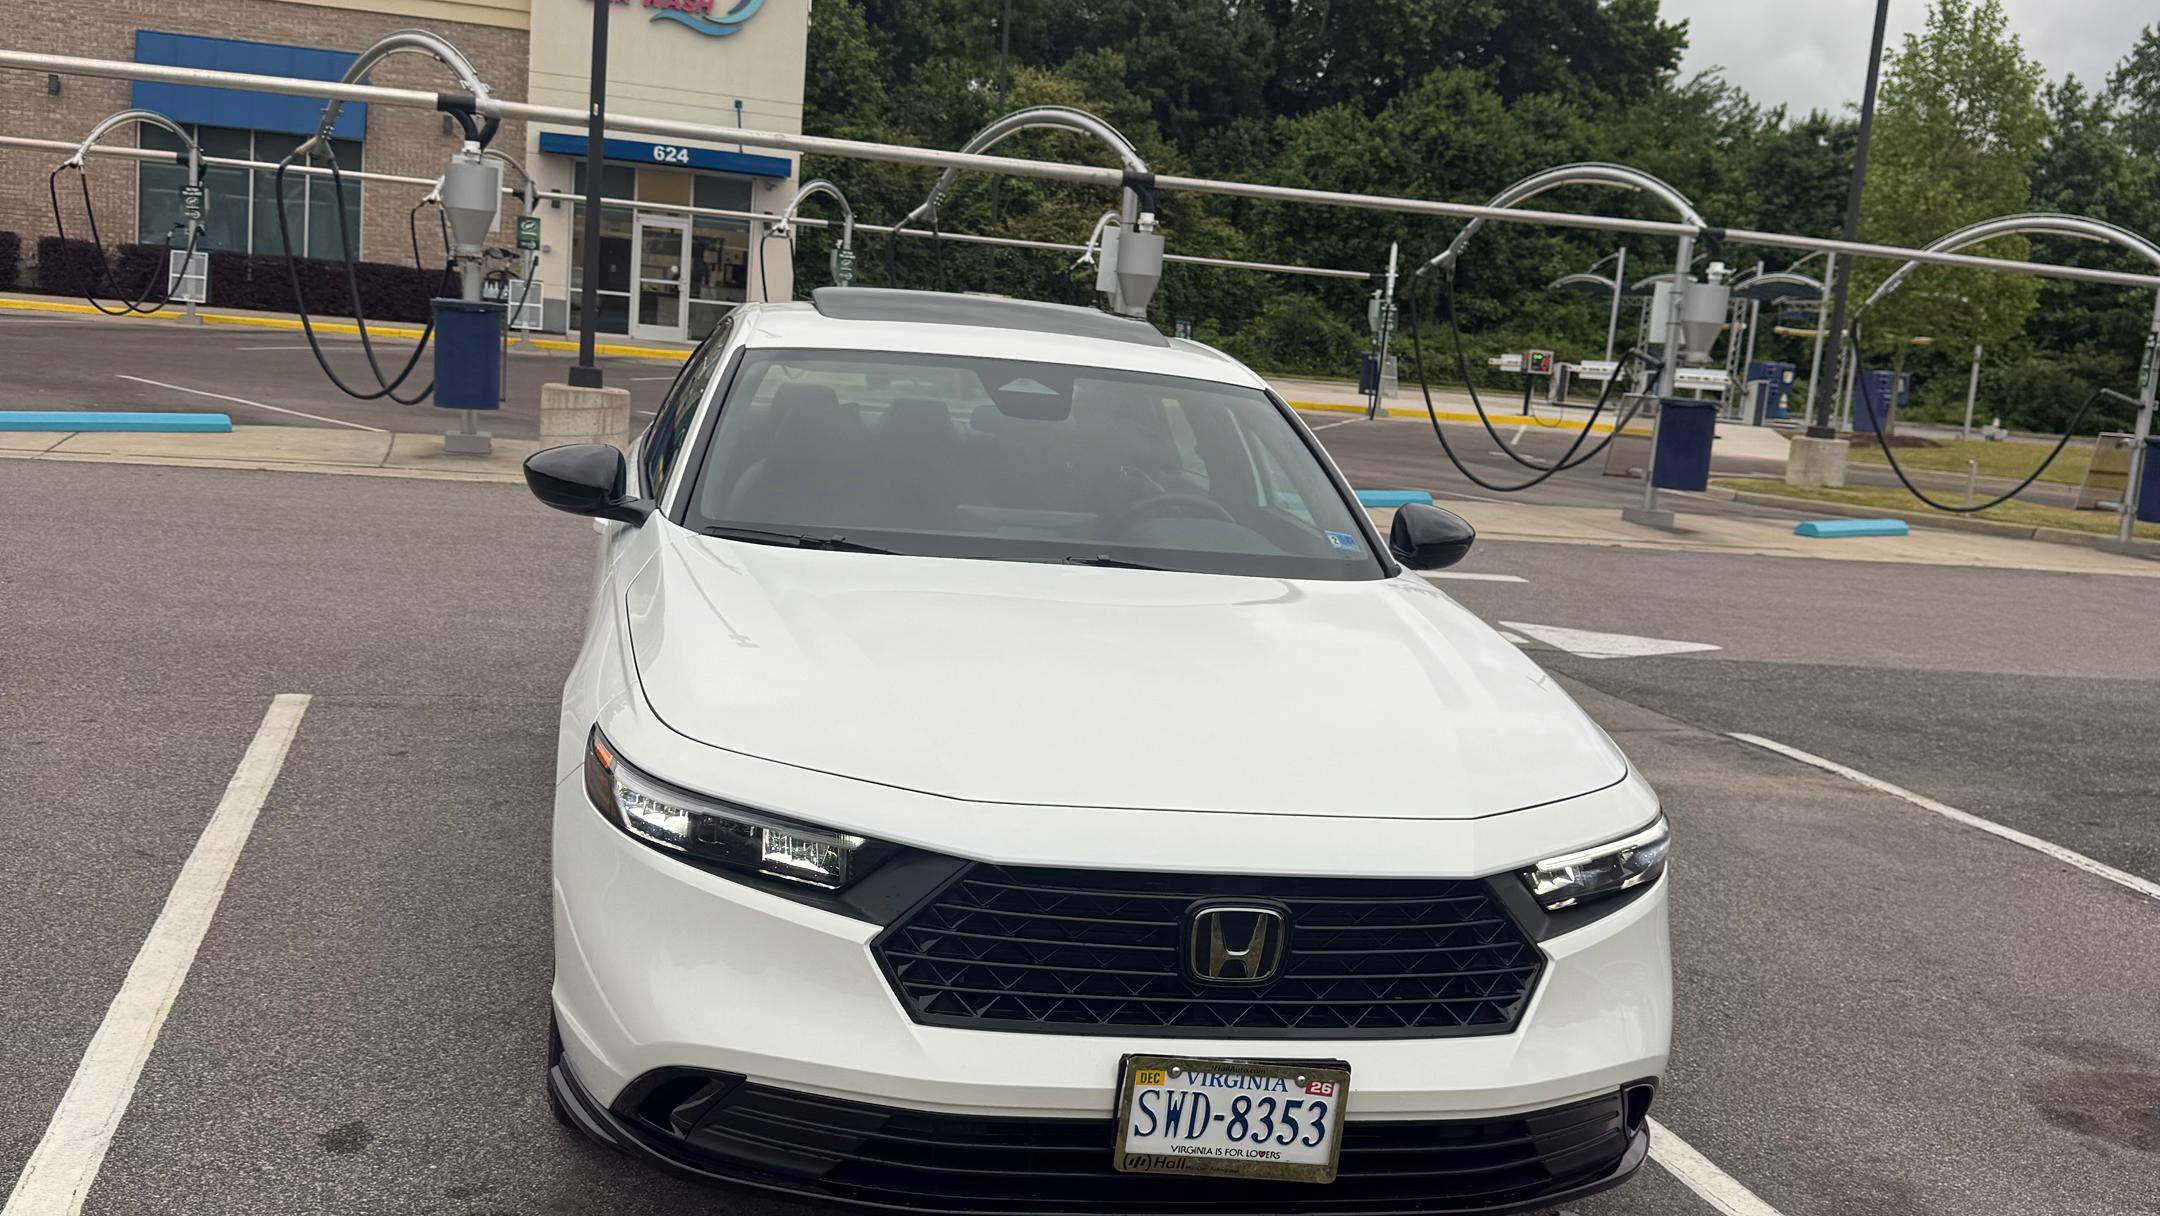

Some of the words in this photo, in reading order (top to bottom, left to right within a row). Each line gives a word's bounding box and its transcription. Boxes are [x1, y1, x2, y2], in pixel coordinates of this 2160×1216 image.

[653, 145, 689, 164] 624
[1140, 1072, 1161, 1084] DEC
[1187, 1071, 1288, 1093] VIRGINIA
[1310, 1081, 1333, 1095] 26
[1134, 1089, 1328, 1148] SWD-8353
[1170, 1145, 1213, 1156] VIRGINIA
[1215, 1148, 1222, 1156] IS
[1224, 1148, 1244, 1157] FOR
[1154, 1156, 1187, 1170] Hall
